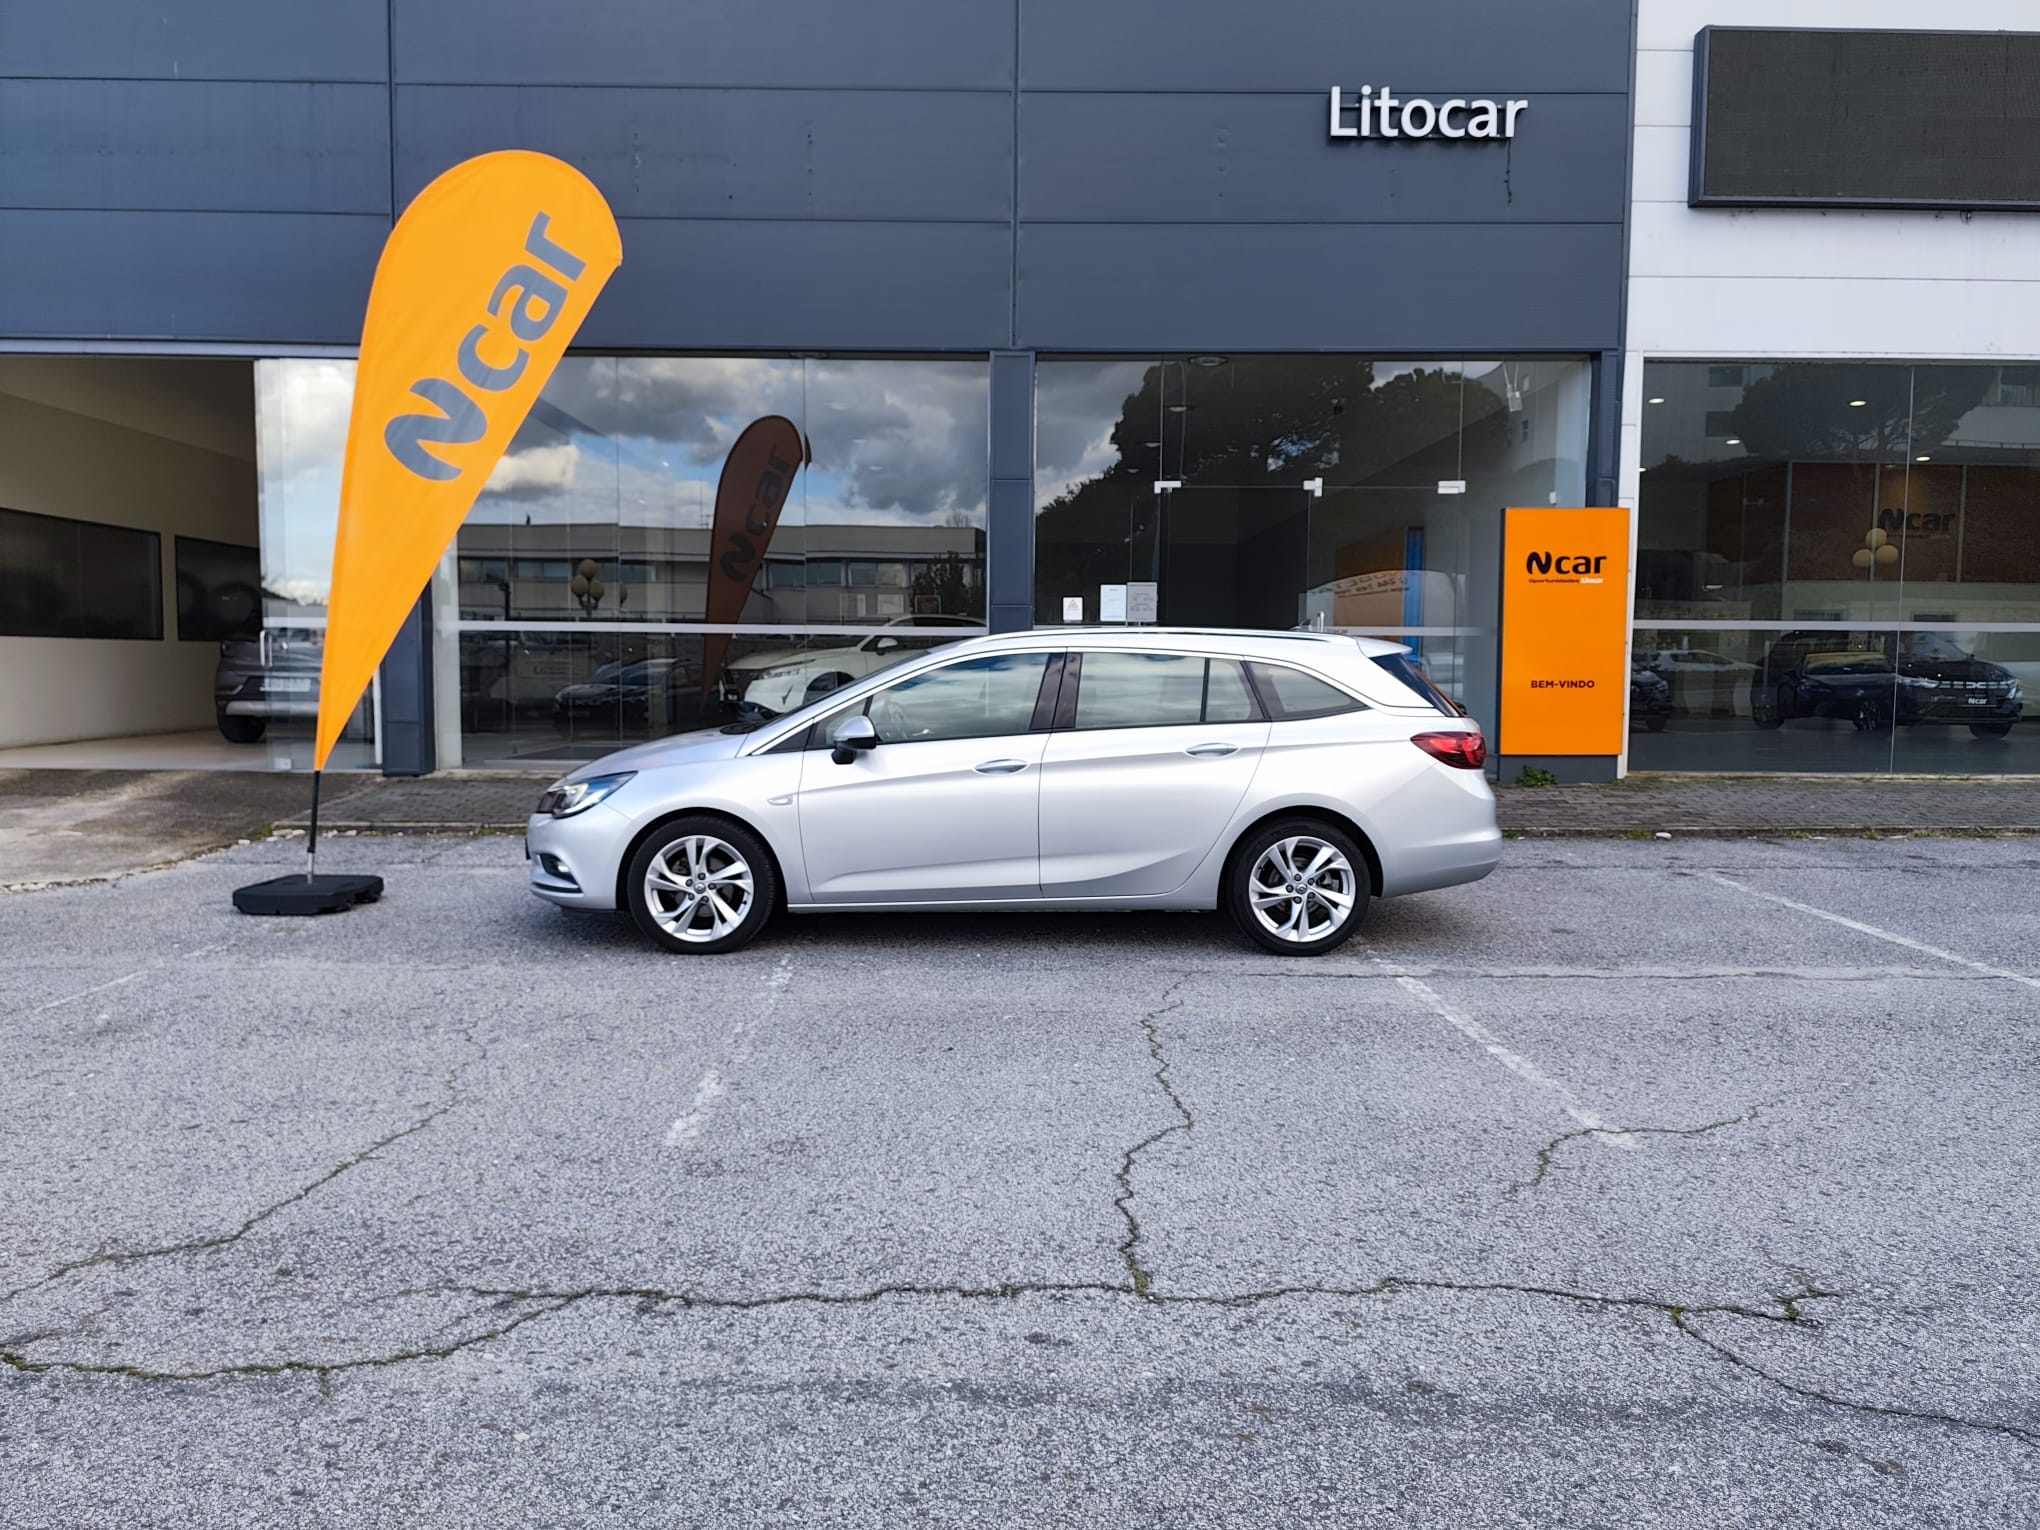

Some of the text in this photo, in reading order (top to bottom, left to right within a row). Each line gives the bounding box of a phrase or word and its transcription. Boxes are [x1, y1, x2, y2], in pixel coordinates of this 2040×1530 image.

[1330, 84, 1529, 138] Litocar
[384, 210, 588, 482] Ncar
[719, 443, 790, 582] Ncar
[1879, 508, 1956, 531] Ncar
[1526, 551, 1607, 575] Ncar
[1530, 680, 1595, 688] BEM-VINDO
